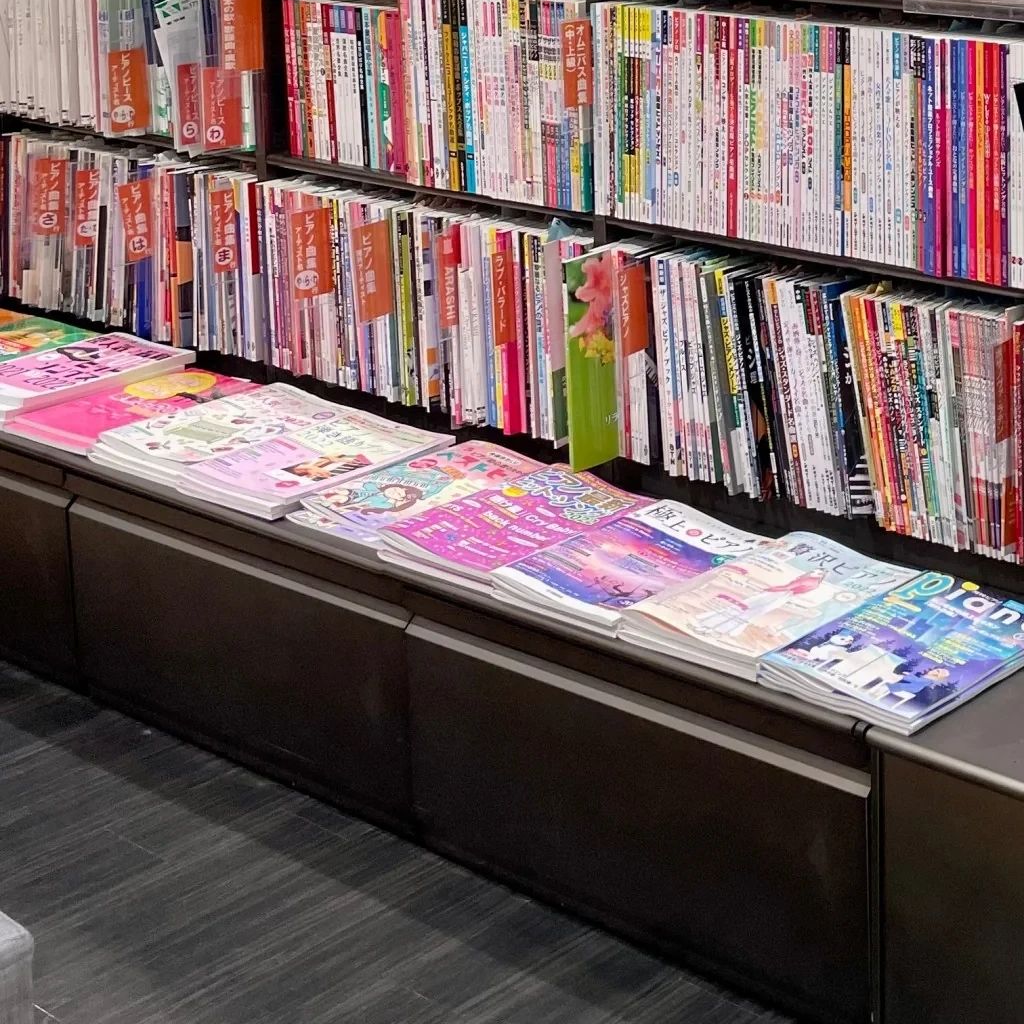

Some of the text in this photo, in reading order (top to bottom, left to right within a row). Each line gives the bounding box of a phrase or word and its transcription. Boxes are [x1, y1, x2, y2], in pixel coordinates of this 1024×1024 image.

[121, 52, 134, 103] ピアノピース
[574, 26, 588, 104] オムニバス曲集
[184, 124, 197, 136] ら
[208, 128, 222, 141] わ
[49, 160, 62, 213] ピアノ曲集
[130, 184, 148, 235] ピアノ曲集
[42, 214, 55, 227] さ
[131, 237, 144, 252] は
[223, 189, 236, 247] ピアノ曲集
[304, 211, 318, 270] ピアノ曲集
[217, 247, 231, 263] ま
[362, 231, 376, 294] ピアノ曲集
[442, 266, 456, 321] ARASHI
[495, 255, 508, 333] ラブ・バラード
[619, 272, 631, 339] ジャズピアノ
